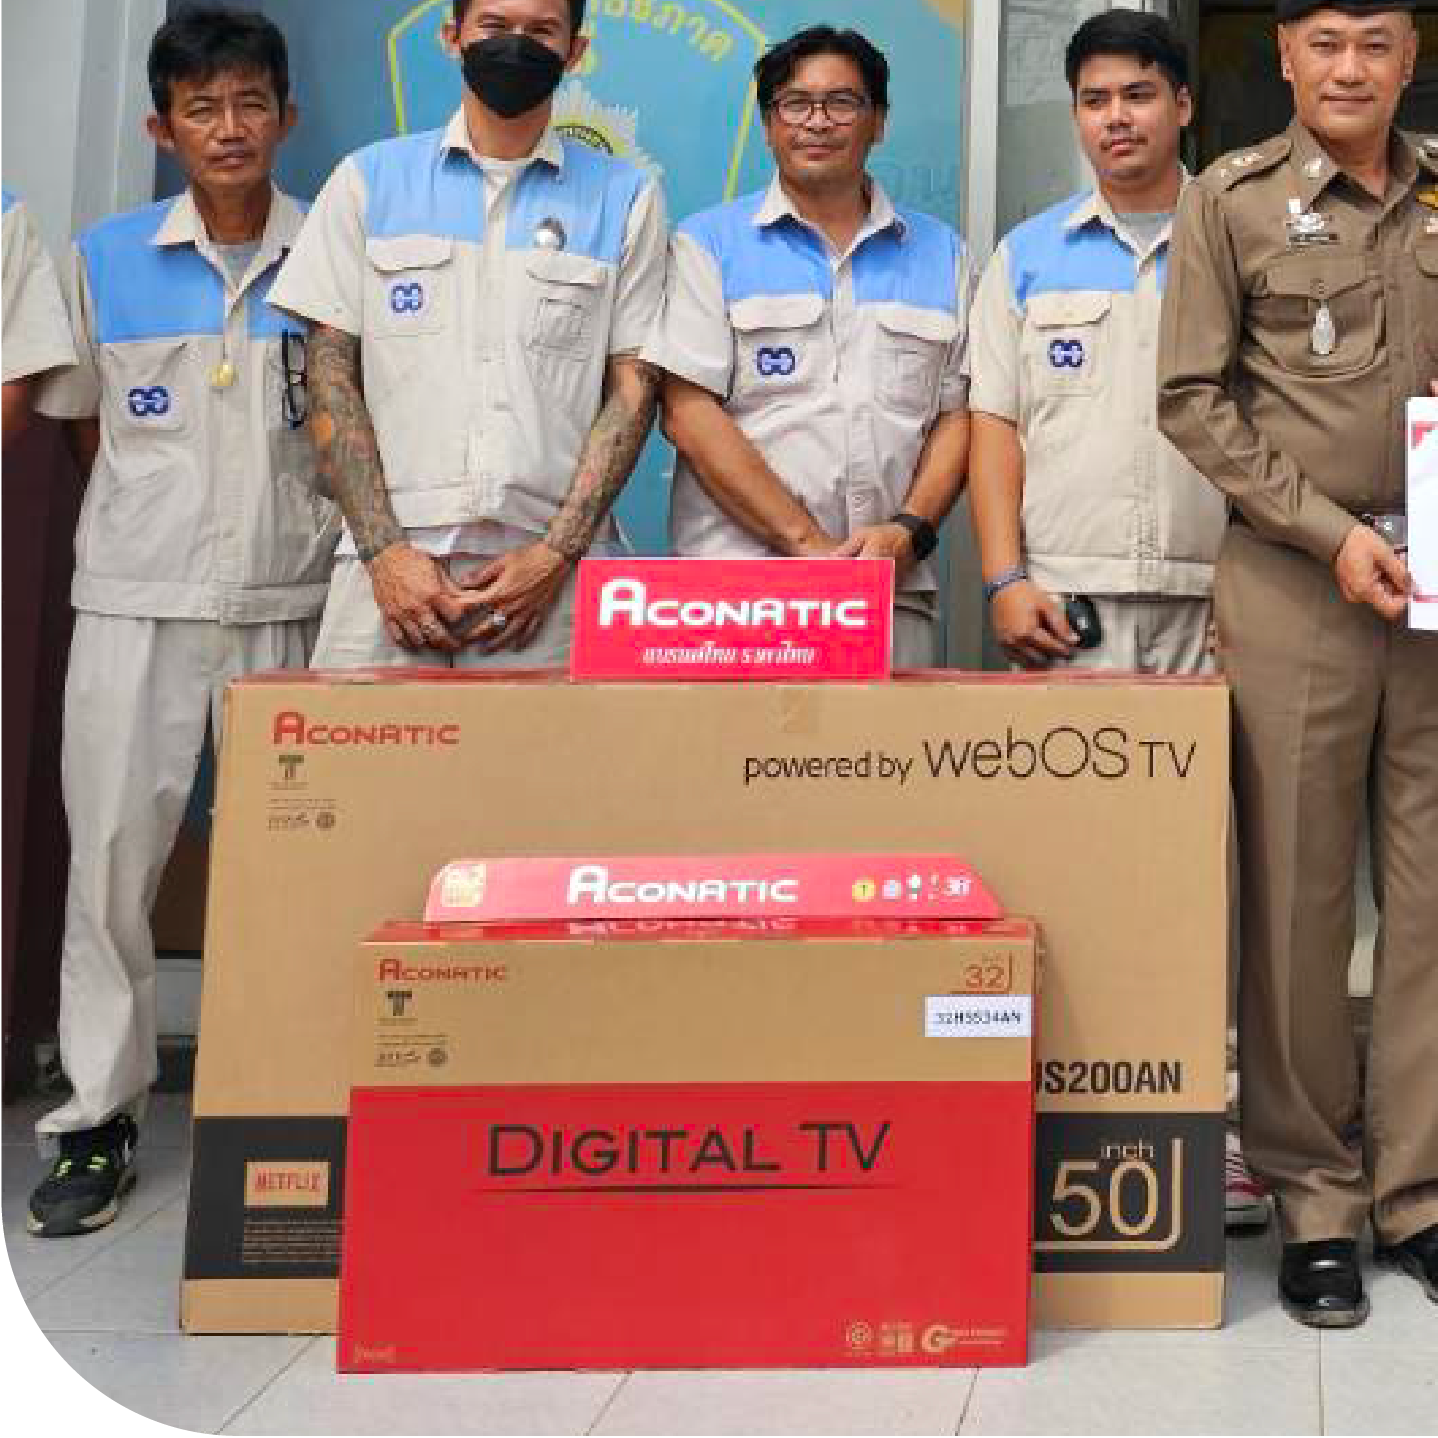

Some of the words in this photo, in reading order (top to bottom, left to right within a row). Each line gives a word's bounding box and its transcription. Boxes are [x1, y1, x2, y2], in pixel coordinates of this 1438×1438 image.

[598, 577, 868, 627] ACONATIC
[273, 711, 460, 745] ACONATIC
[743, 751, 872, 785] powered
[877, 752, 914, 786] by
[922, 726, 1131, 780] webOS
[1138, 740, 1198, 779] TV
[566, 864, 800, 906] ACONATIC
[964, 963, 1006, 990] 32
[1036, 1061, 1182, 1095] S200AN
[488, 1123, 782, 1176] DIGITAL
[798, 1119, 894, 1173] TV
[1101, 1137, 1155, 1160] inch
[1049, 1157, 1160, 1236] 50
